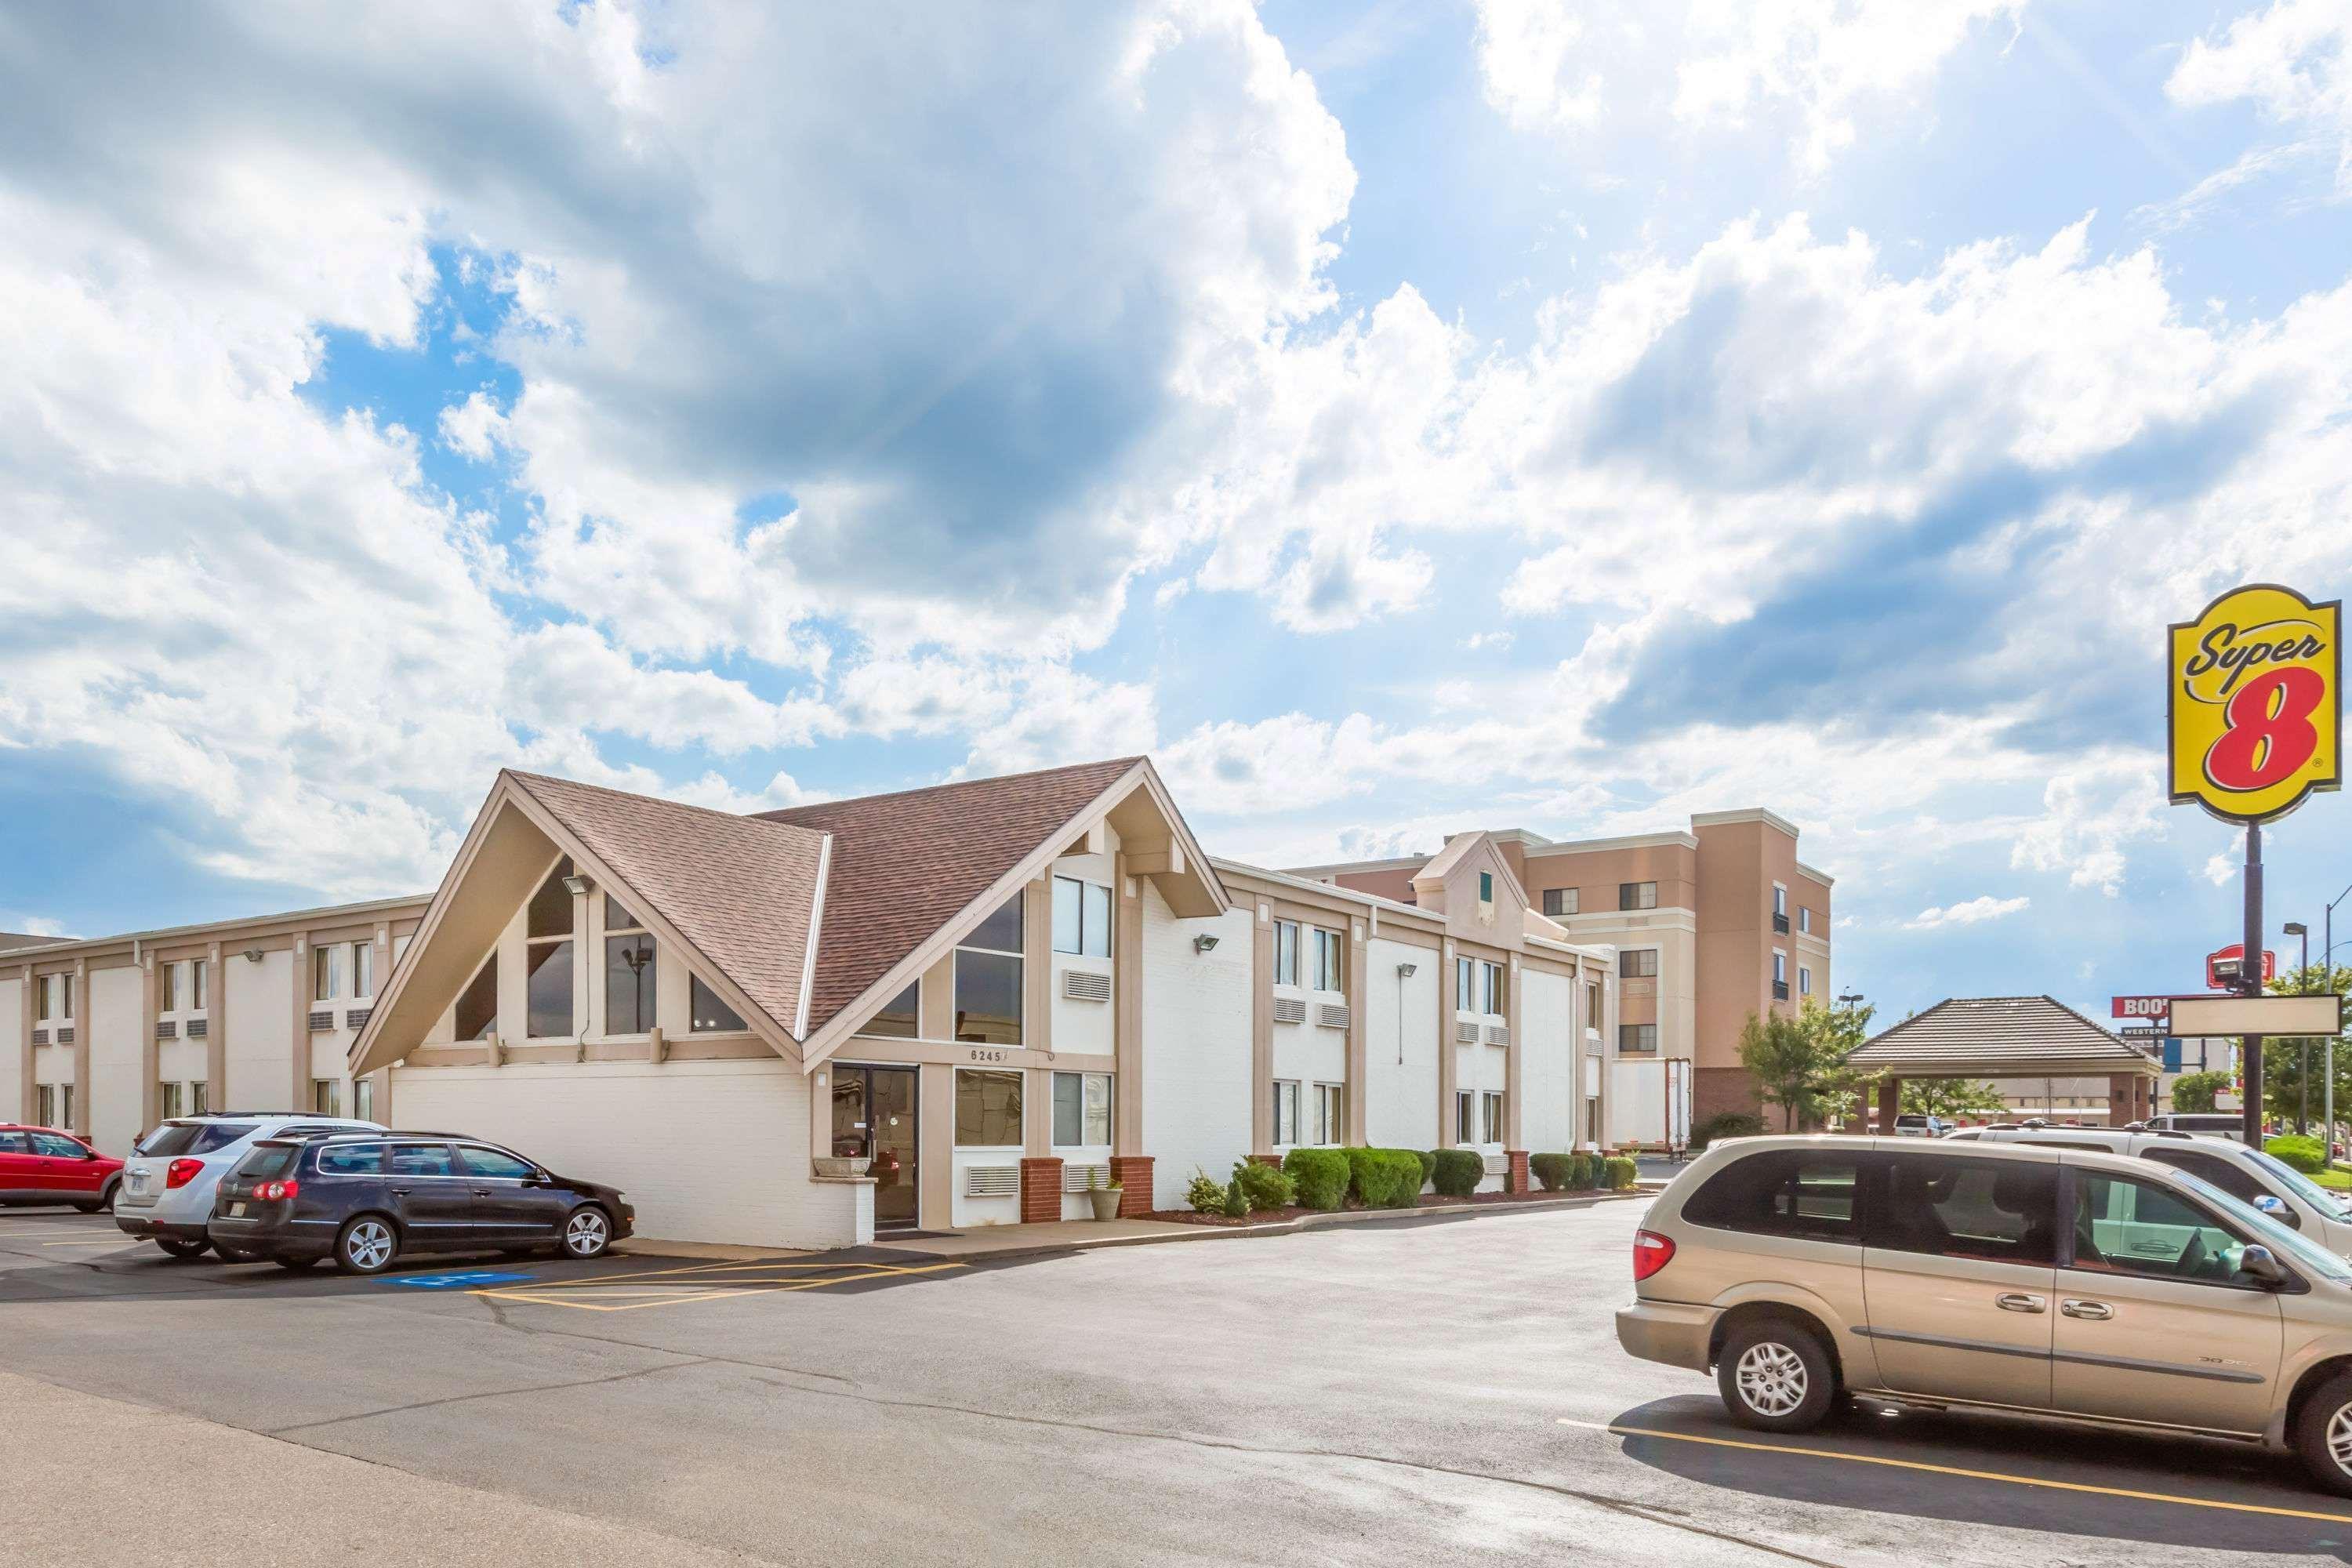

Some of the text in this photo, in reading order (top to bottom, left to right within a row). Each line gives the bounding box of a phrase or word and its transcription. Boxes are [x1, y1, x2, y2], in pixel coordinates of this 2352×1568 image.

[2185, 622, 2326, 695] Super
[2202, 666, 2325, 793] 8
[971, 1050, 1000, 1062] 6245
